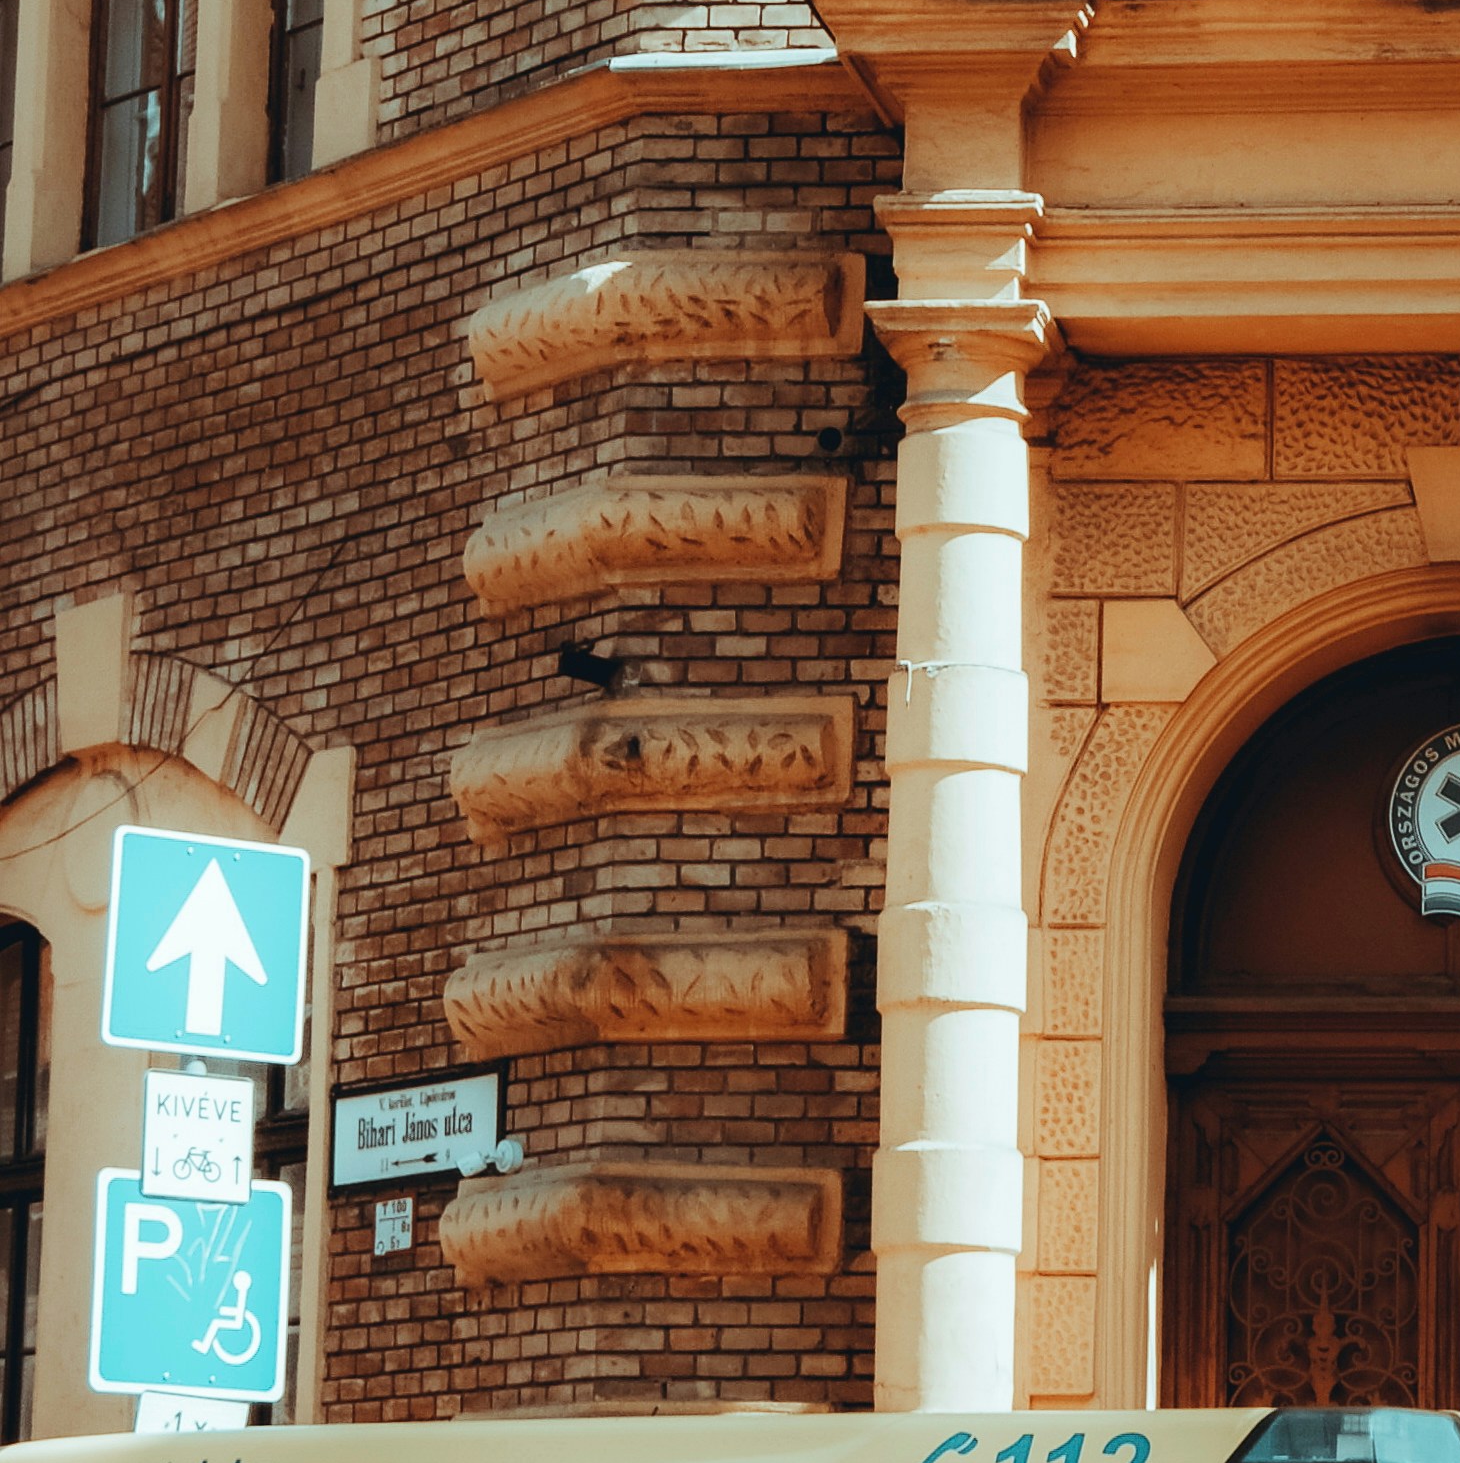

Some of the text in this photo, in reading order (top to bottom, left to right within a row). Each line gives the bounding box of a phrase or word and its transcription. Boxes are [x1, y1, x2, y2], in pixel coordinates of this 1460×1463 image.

[1396, 746, 1439, 865] ORSZÁGOS
[156, 1091, 243, 1124] KIVÉVE
[357, 1105, 473, 1150] Bihari János utca
[121, 1202, 184, 1295] P
